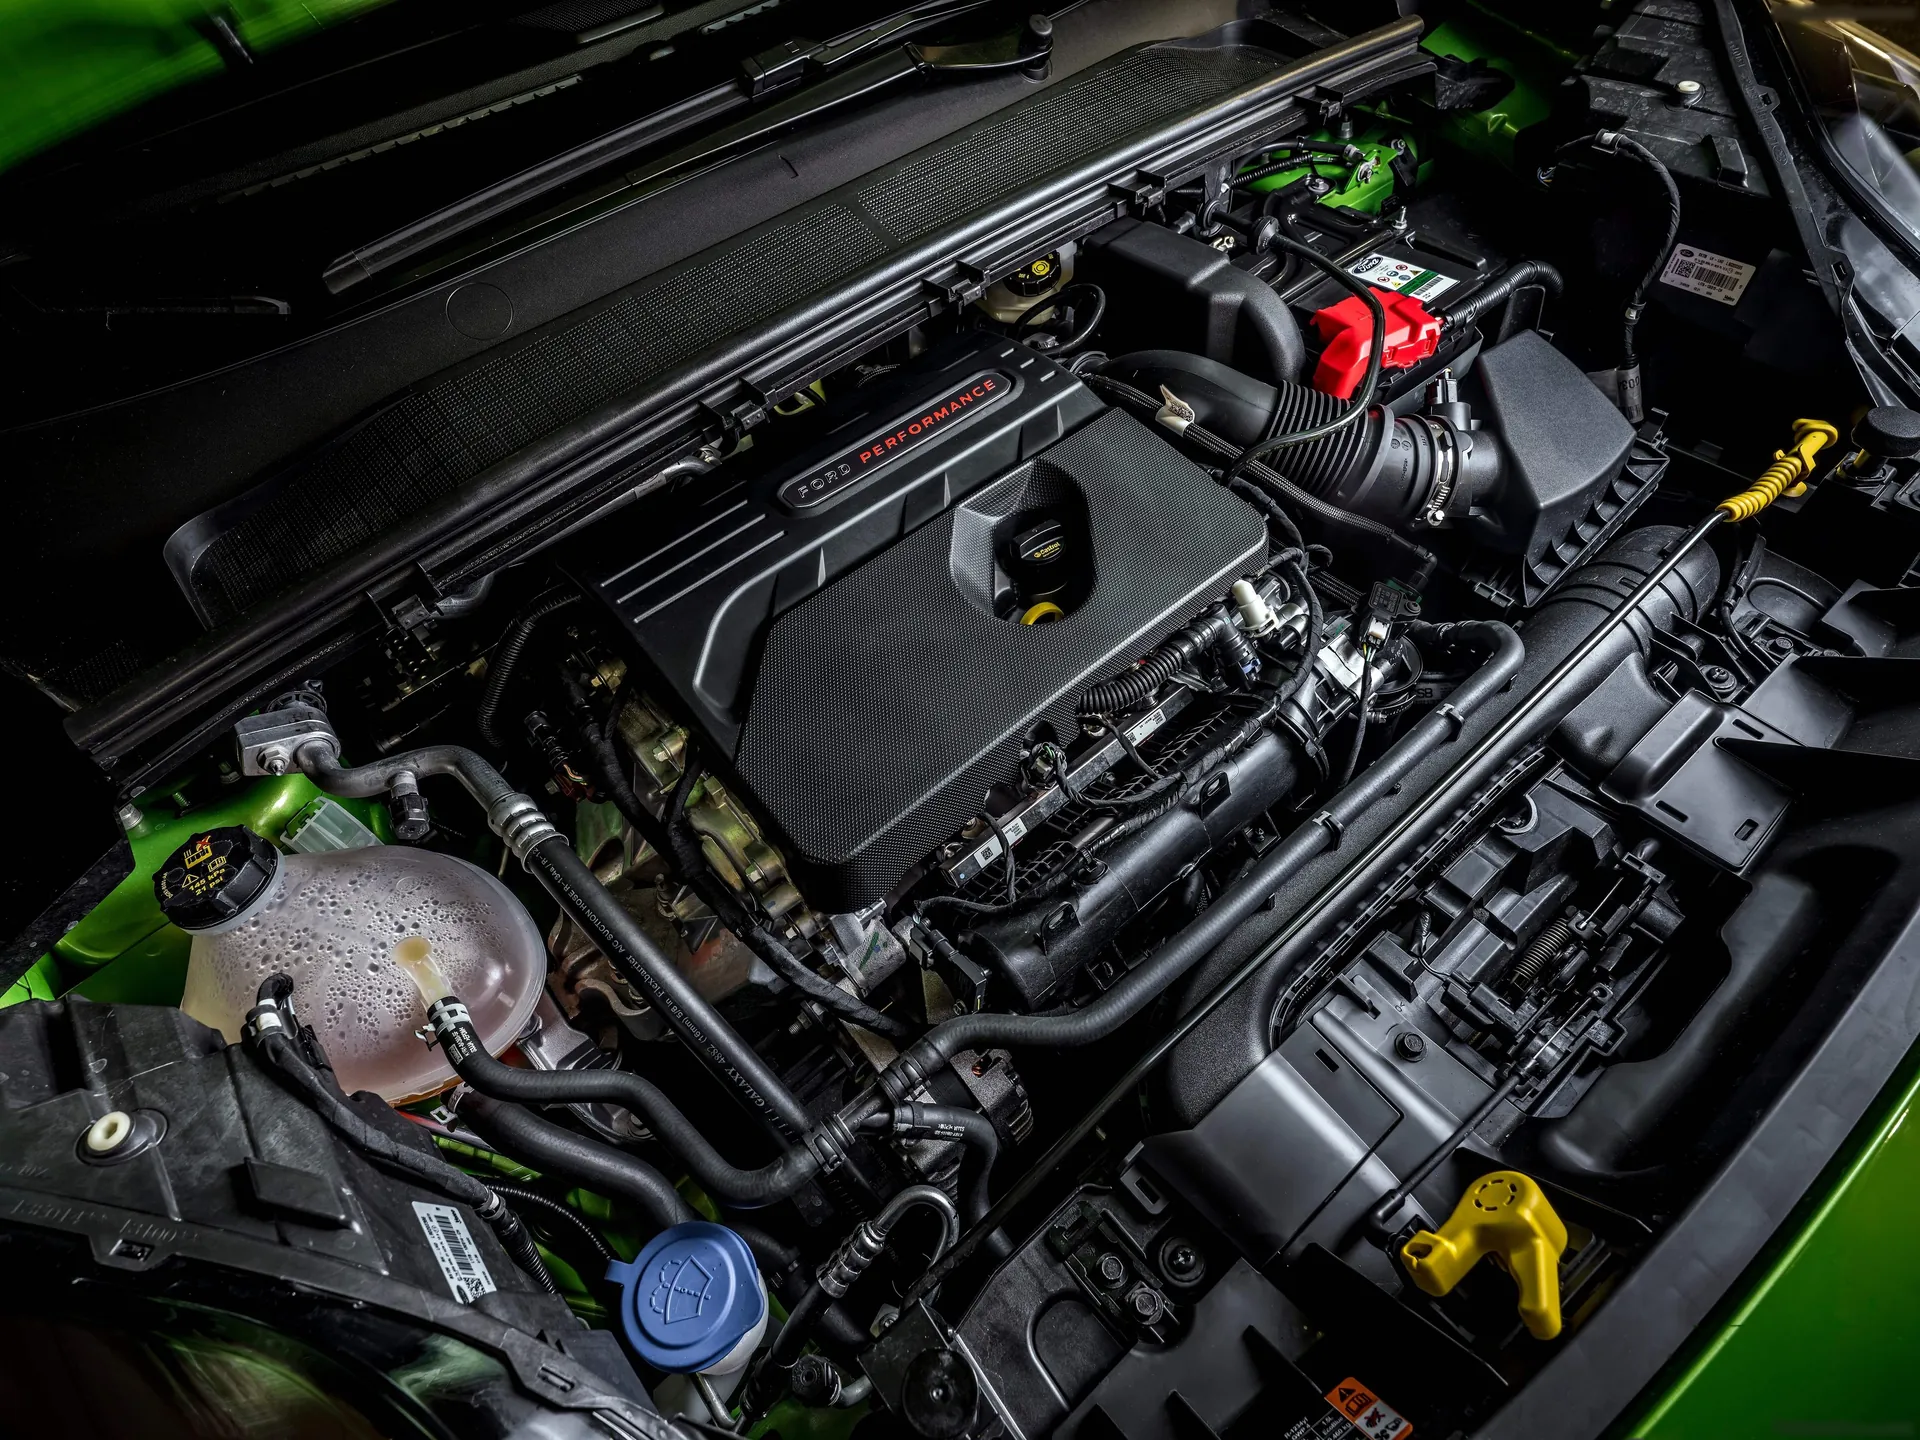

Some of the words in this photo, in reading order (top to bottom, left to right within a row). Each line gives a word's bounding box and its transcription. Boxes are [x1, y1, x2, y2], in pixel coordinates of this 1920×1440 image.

[1357, 258, 1380, 272] Ford
[797, 463, 851, 498] FORD
[859, 379, 996, 464] PERFORMANCE
[1040, 541, 1061, 555] Castrol
[189, 879, 206, 891] 145
[207, 868, 226, 881] kPa
[195, 886, 206, 896] 21
[209, 876, 224, 889] psi
[567, 890, 588, 912] HOSE
[586, 909, 615, 942] SUCTION
[612, 940, 626, 954] A/C
[626, 955, 666, 998] Flexbarrier
[672, 1004, 684, 1019] 5/8
[681, 1016, 708, 1044] (16mm)
[707, 1045, 726, 1066] 4882
[725, 1066, 766, 1107] GALAXY
[1283, 1416, 1309, 1440] R-1234yf
[1322, 1416, 1344, 1435] EcoBlue
[1342, 1422, 1352, 1432] kg
